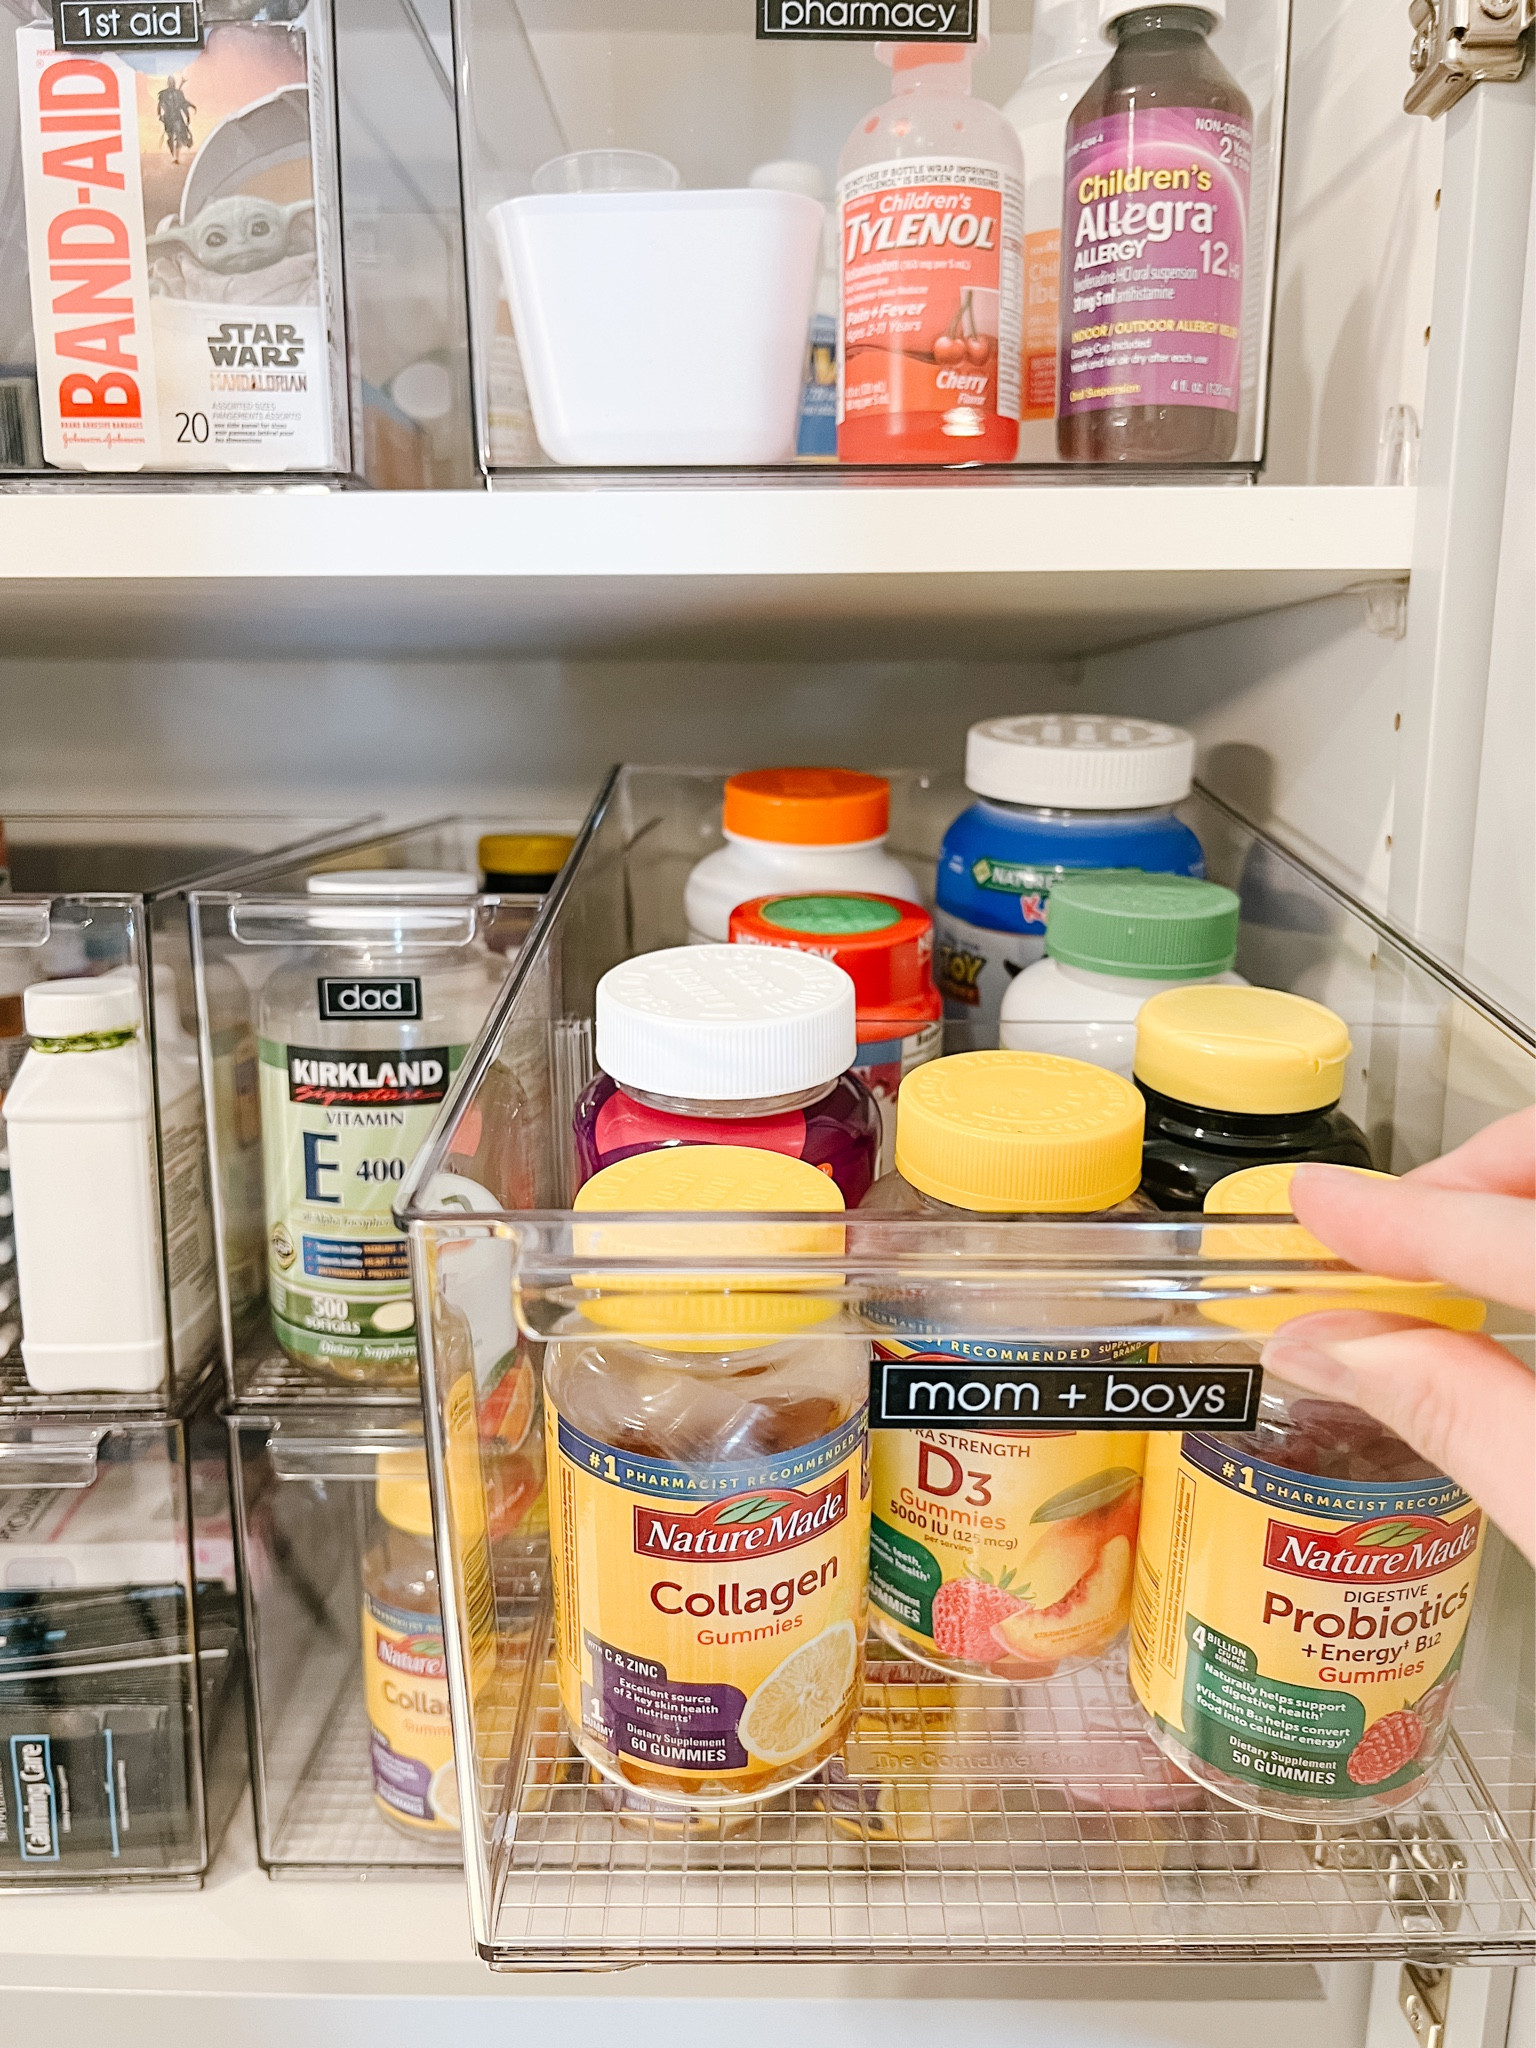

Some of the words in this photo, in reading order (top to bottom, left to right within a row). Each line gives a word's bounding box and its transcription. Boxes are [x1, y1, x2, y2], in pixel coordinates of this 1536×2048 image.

[77, 7, 121, 37] 1st
[130, 6, 181, 36] aid
[781, 0, 957, 32] pharmacy
[1219, 136, 1232, 164] 2
[1078, 164, 1212, 204] Children's
[879, 192, 972, 214] Children's
[38, 58, 142, 418] BAND-AID
[845, 212, 996, 264] TYLENOL
[1074, 199, 1214, 248] Allegra
[1074, 239, 1147, 272] ALLERGY
[1199, 239, 1229, 276] 12
[207, 323, 304, 344] STAR
[1114, 319, 1176, 335] OUTDOOR
[209, 346, 304, 367] WARS
[936, 370, 988, 394] Cherry
[175, 412, 209, 443] 20
[337, 984, 402, 1010] dad
[292, 1058, 444, 1088] KIRKLAND
[325, 1111, 404, 1126] VITAMIN
[303, 1131, 342, 1203] E
[356, 1158, 406, 1181] 400
[311, 1298, 349, 1321] 500
[951, 1340, 1091, 1361] RECOMMENDED
[1112, 1341, 1142, 1359] BRAND
[908, 1381, 1040, 1411] mom
[1057, 1384, 1087, 1409] +
[1104, 1375, 1226, 1419] boys
[938, 1433, 1031, 1458] STRENGTH
[588, 1450, 621, 1483] #1
[626, 1469, 739, 1489] PHARMACIST
[748, 1434, 854, 1487] RECOMMENDED
[917, 1441, 992, 1507] D3
[1221, 1461, 1258, 1496] #1
[1266, 1482, 1387, 1511] PHARMACIST
[1394, 1487, 1468, 1511] RECOMM
[900, 1487, 1006, 1531] Gummies
[890, 1500, 927, 1529] 5000
[931, 1519, 949, 1537] IU
[953, 1528, 980, 1544] (125
[983, 1536, 1018, 1551] mcg)
[924, 1533, 940, 1545] per
[941, 1537, 973, 1554] serving
[650, 1555, 838, 1616] Collagen
[1344, 1584, 1429, 1604] DIGESTIVE
[1262, 1582, 1469, 1640] Probiotics
[697, 1614, 804, 1646] Gummies
[1191, 1625, 1207, 1652] 4
[1207, 1632, 1248, 1659] BILLION
[1414, 1632, 1442, 1655] B12
[604, 1648, 613, 1662] C
[614, 1653, 625, 1668] &
[626, 1658, 659, 1679] ZINC
[1217, 1648, 1231, 1661] CFU
[1231, 1653, 1247, 1666] PER
[1204, 1662, 1258, 1696] Naturally
[1259, 1687, 1294, 1706] helps
[1295, 1698, 1347, 1713] support
[1318, 1660, 1425, 1686] Gummies
[613, 1686, 624, 1696] of
[625, 1691, 633, 1700] 2
[633, 1692, 653, 1708] key
[654, 1699, 679, 1713] skin
[680, 1703, 719, 1714] health
[619, 1677, 669, 1700] Excellent
[671, 1693, 712, 1704] source
[1221, 1684, 1277, 1712] digestive
[590, 1697, 605, 1724] 1
[1196, 1694, 1222, 1716] food
[1223, 1709, 1248, 1727] into
[1250, 1720, 1298, 1742] cellular
[1246, 1709, 1265, 1723] B12
[1265, 1714, 1300, 1732] helps
[1301, 1724, 1351, 1737] convert
[582, 1714, 614, 1739] GUMMY
[626, 1722, 662, 1743] Dietary
[664, 1734, 726, 1748] Supplement
[20, 1743, 45, 1782] Care
[631, 1737, 647, 1752] 60
[650, 1743, 727, 1763] GUMMIES
[1229, 1735, 1268, 1759] Dietary
[1270, 1751, 1337, 1770] Supplement
[1232, 1750, 1250, 1767] 50
[1253, 1758, 1336, 1785] GUMMIES
[24, 1782, 52, 1854] Calming
